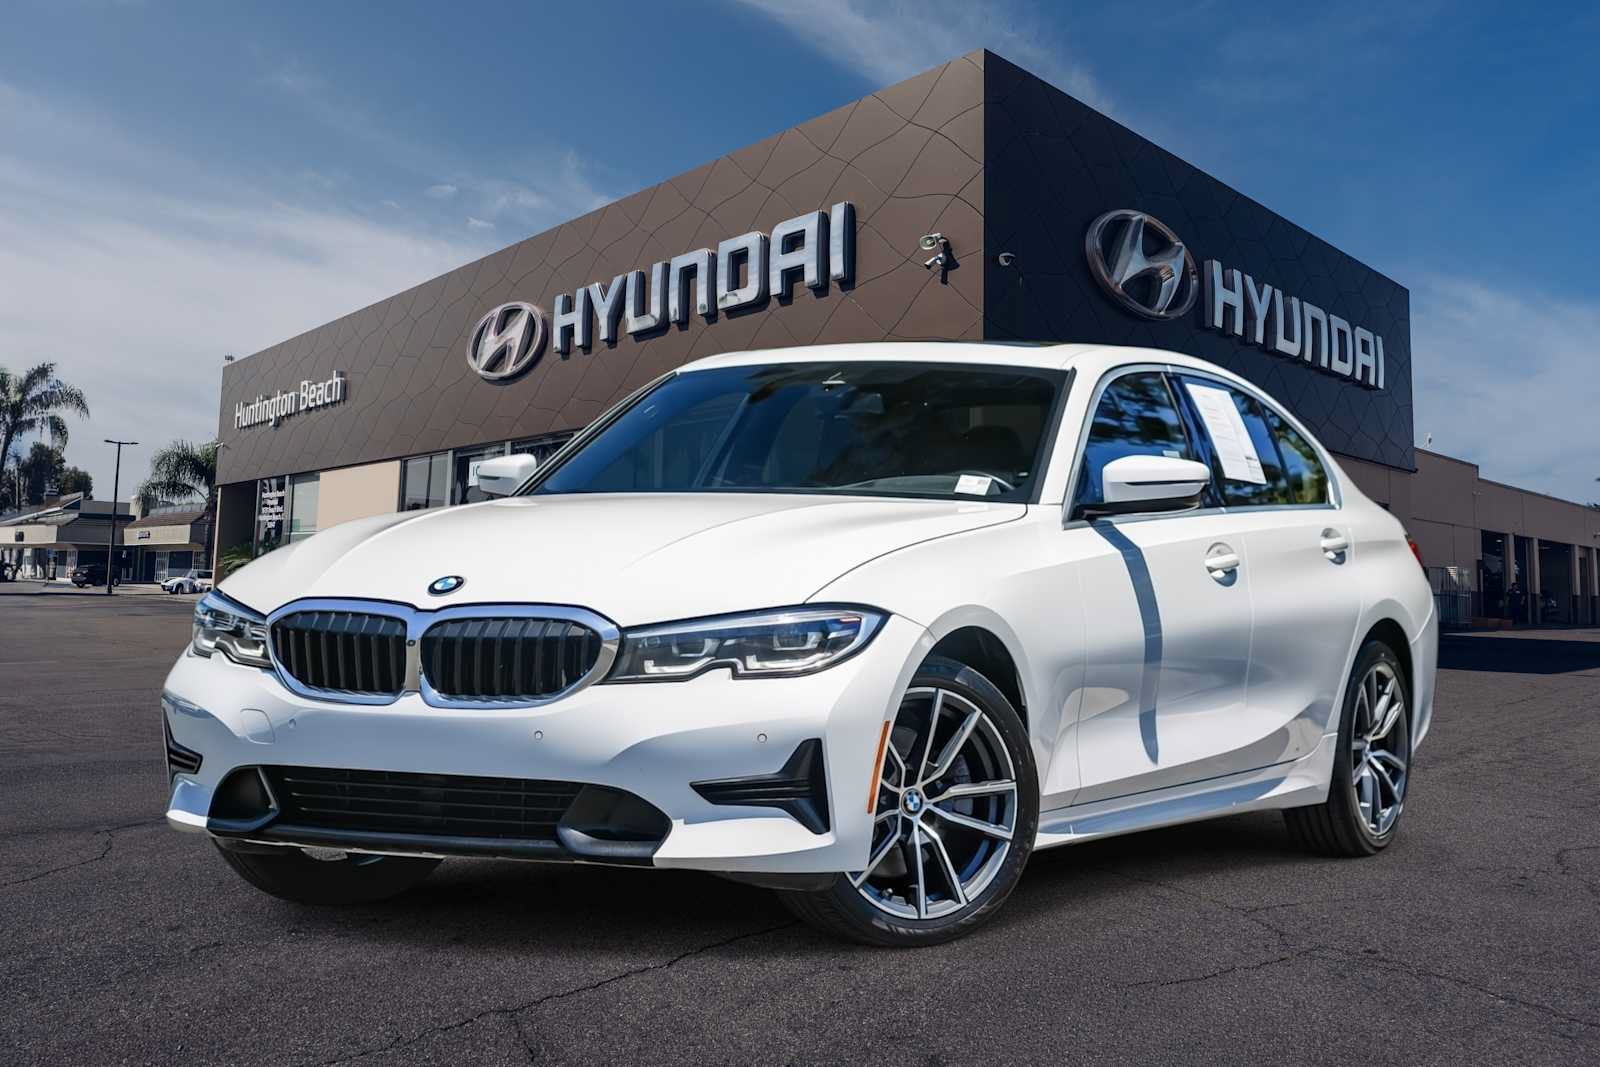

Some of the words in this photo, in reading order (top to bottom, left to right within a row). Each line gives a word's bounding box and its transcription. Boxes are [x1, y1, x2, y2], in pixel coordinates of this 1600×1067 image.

[553, 201, 854, 352] HYUNDAI
[1204, 258, 1385, 389] HYUNDAI
[234, 390, 298, 429] Huntington
[300, 370, 344, 410] Beach
